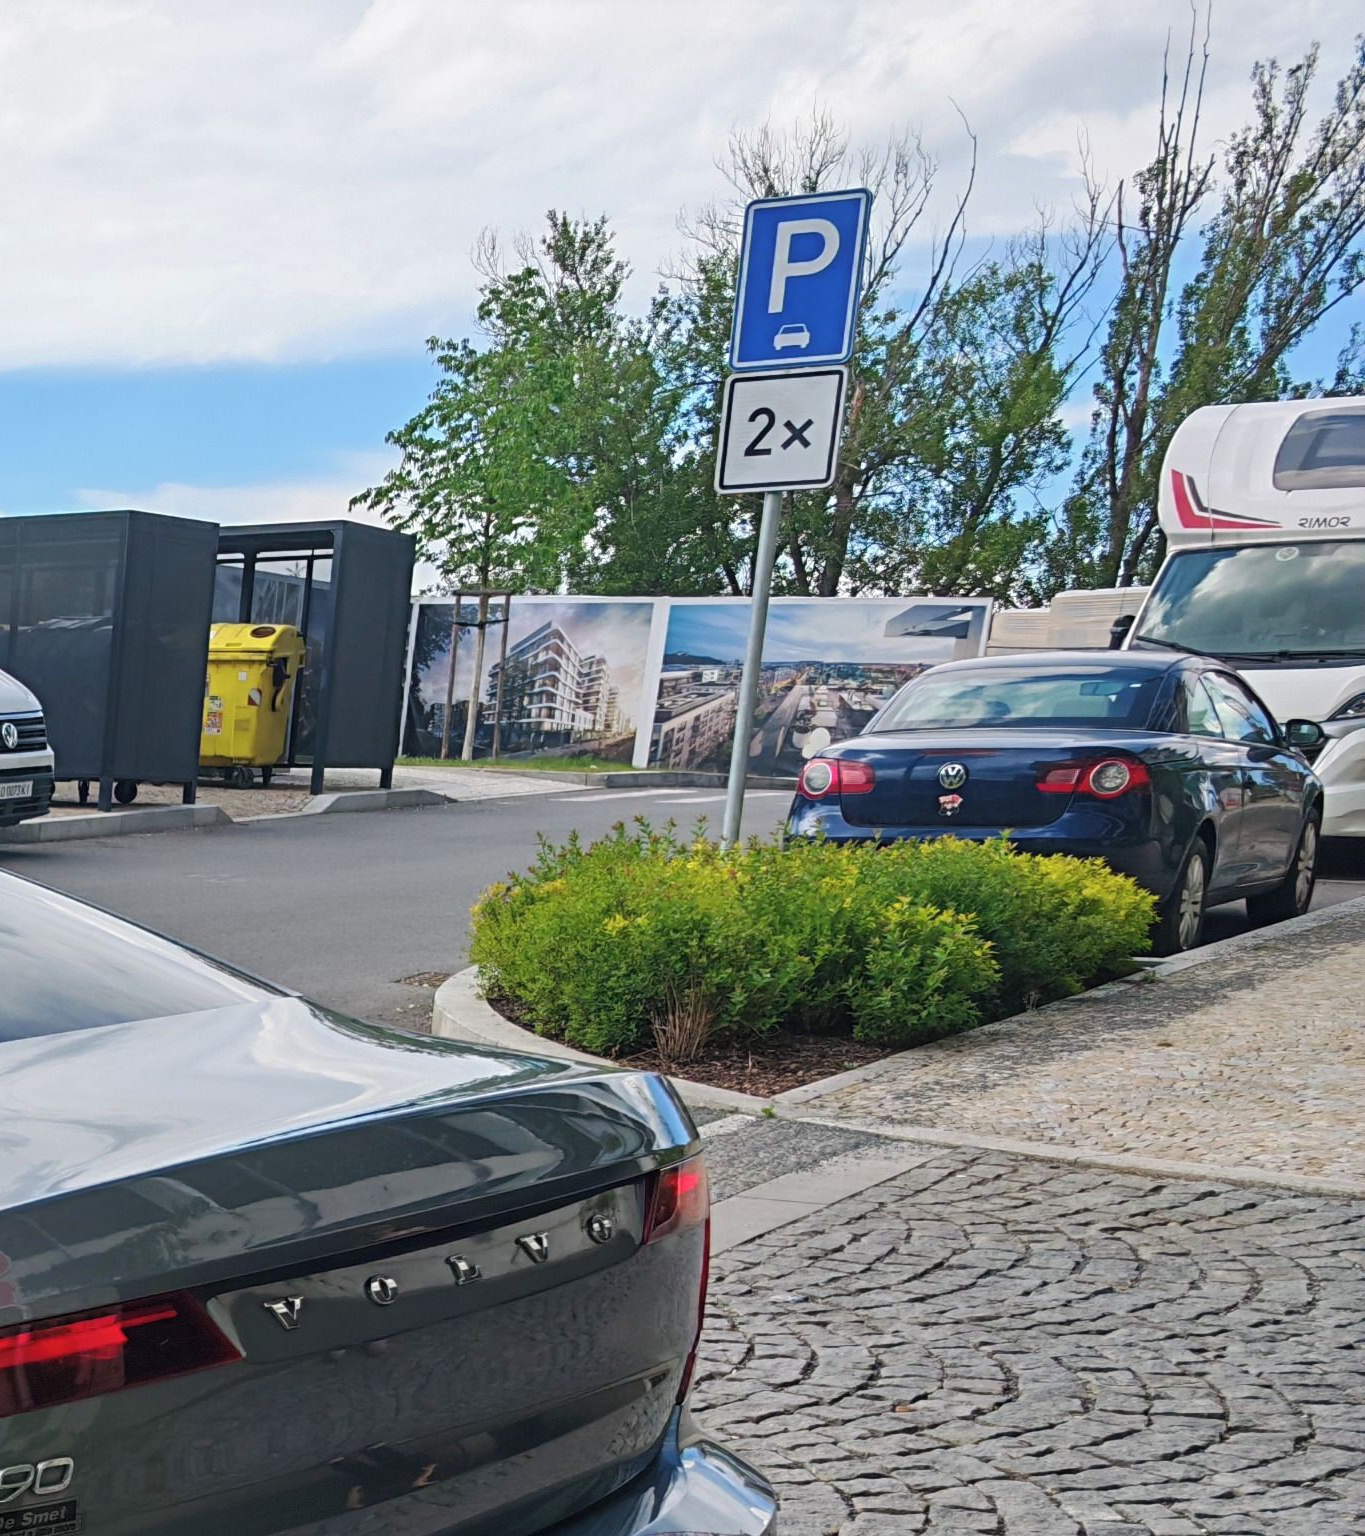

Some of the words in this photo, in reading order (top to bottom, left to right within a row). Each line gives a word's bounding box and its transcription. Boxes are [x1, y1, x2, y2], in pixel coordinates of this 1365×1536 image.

[768, 218, 840, 314] P
[1297, 516, 1351, 529] RIMOR
[263, 1213, 616, 1330] VOLVO
[20, 1505, 67, 1527] Smet
